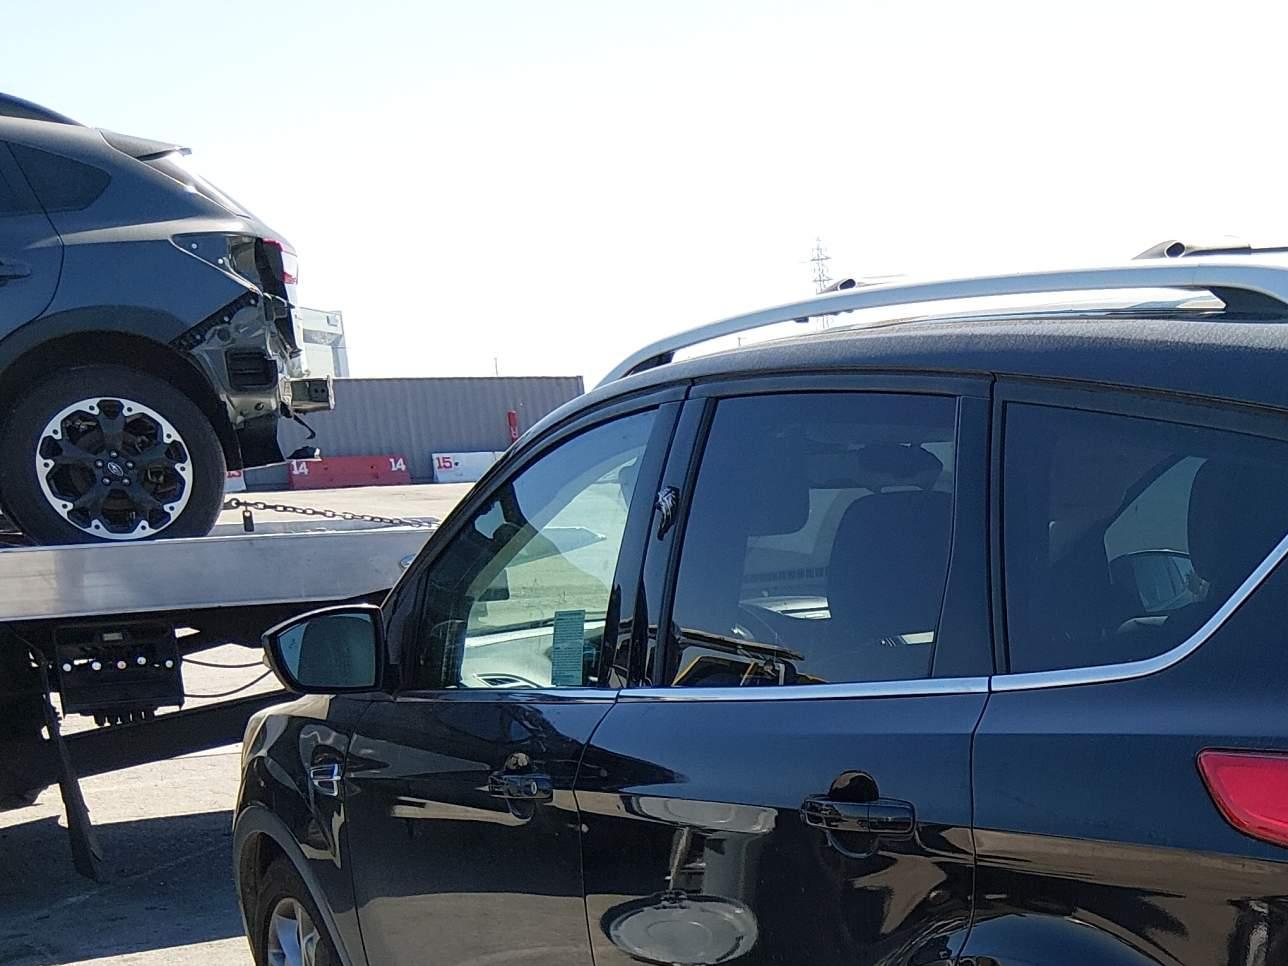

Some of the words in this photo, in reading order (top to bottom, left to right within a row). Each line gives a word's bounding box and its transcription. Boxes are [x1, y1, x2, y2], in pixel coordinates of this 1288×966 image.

[291, 460, 308, 475] 14
[389, 457, 406, 471] 14
[436, 456, 453, 470] 15
